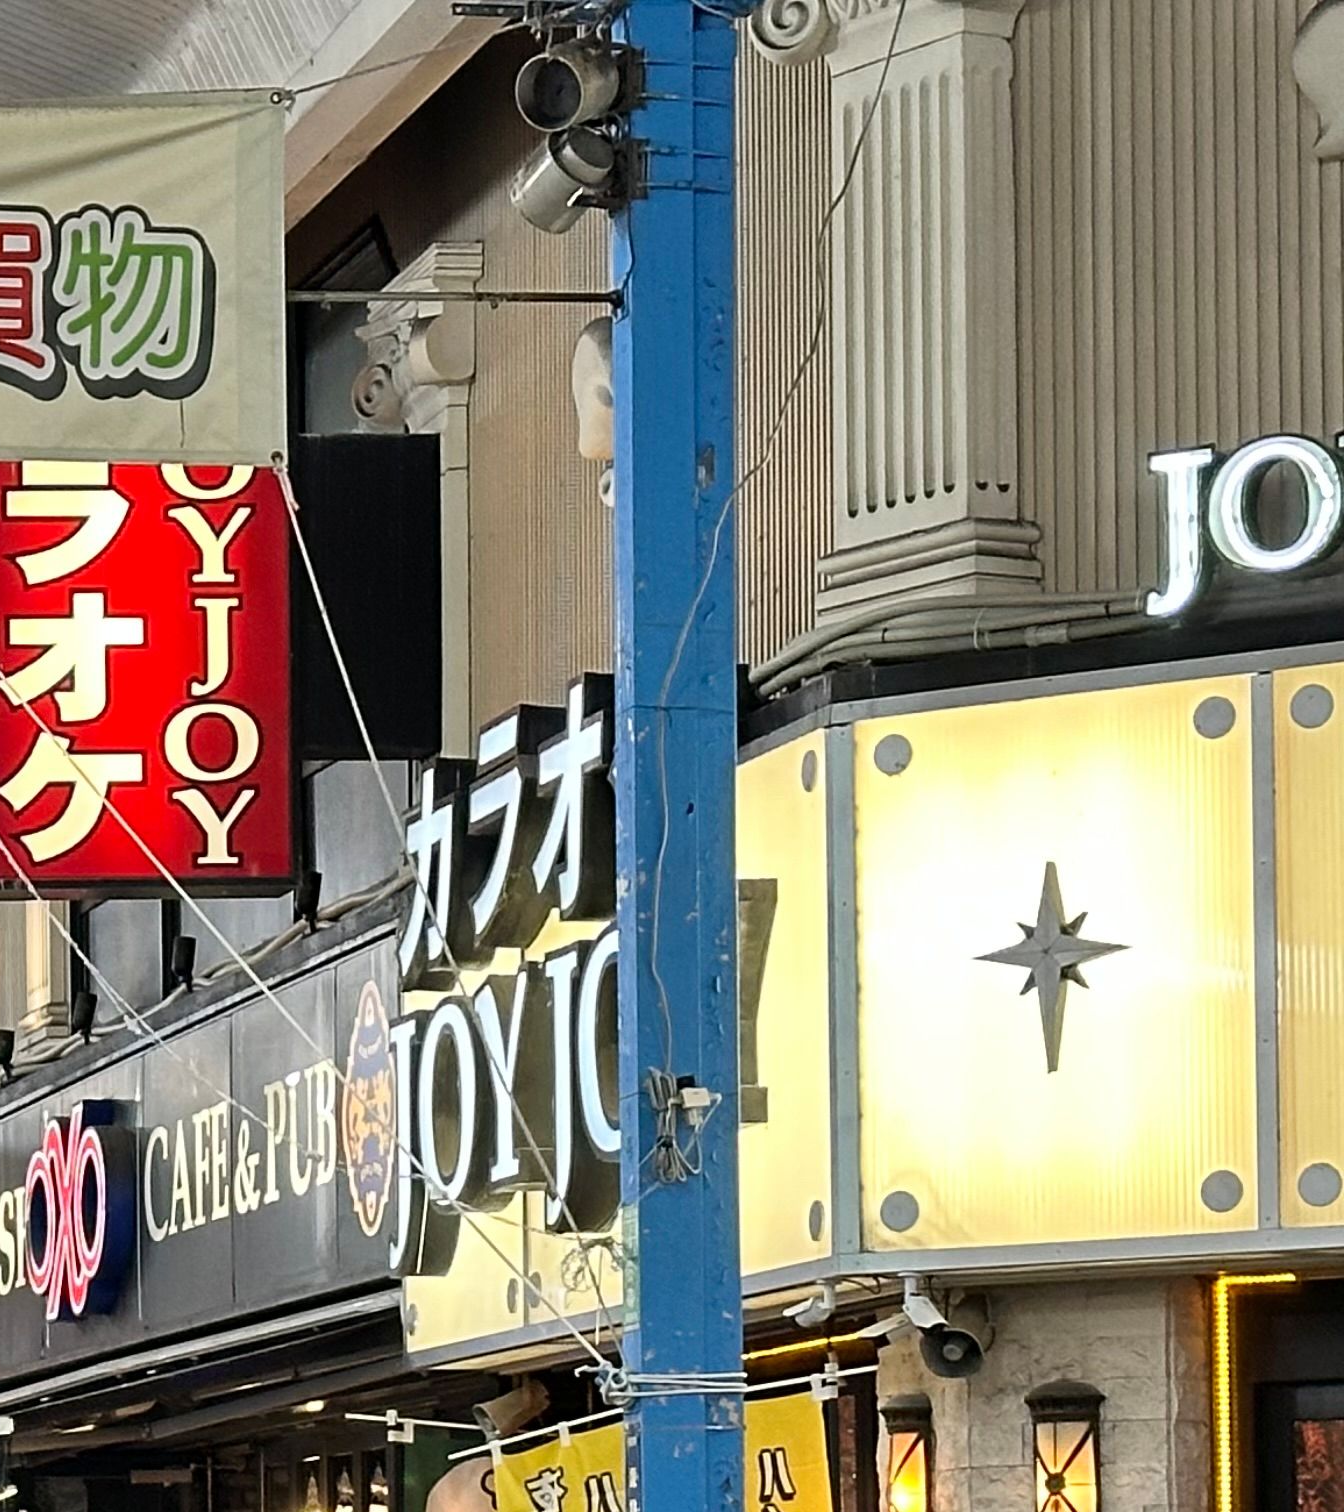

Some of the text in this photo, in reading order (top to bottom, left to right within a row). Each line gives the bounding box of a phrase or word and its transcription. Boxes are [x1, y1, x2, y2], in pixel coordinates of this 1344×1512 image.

[1147, 434, 1344, 616] JO
[144, 1100, 230, 1243] CAFE
[263, 1064, 337, 1205] PUB
[389, 969, 527, 1270] JOY
